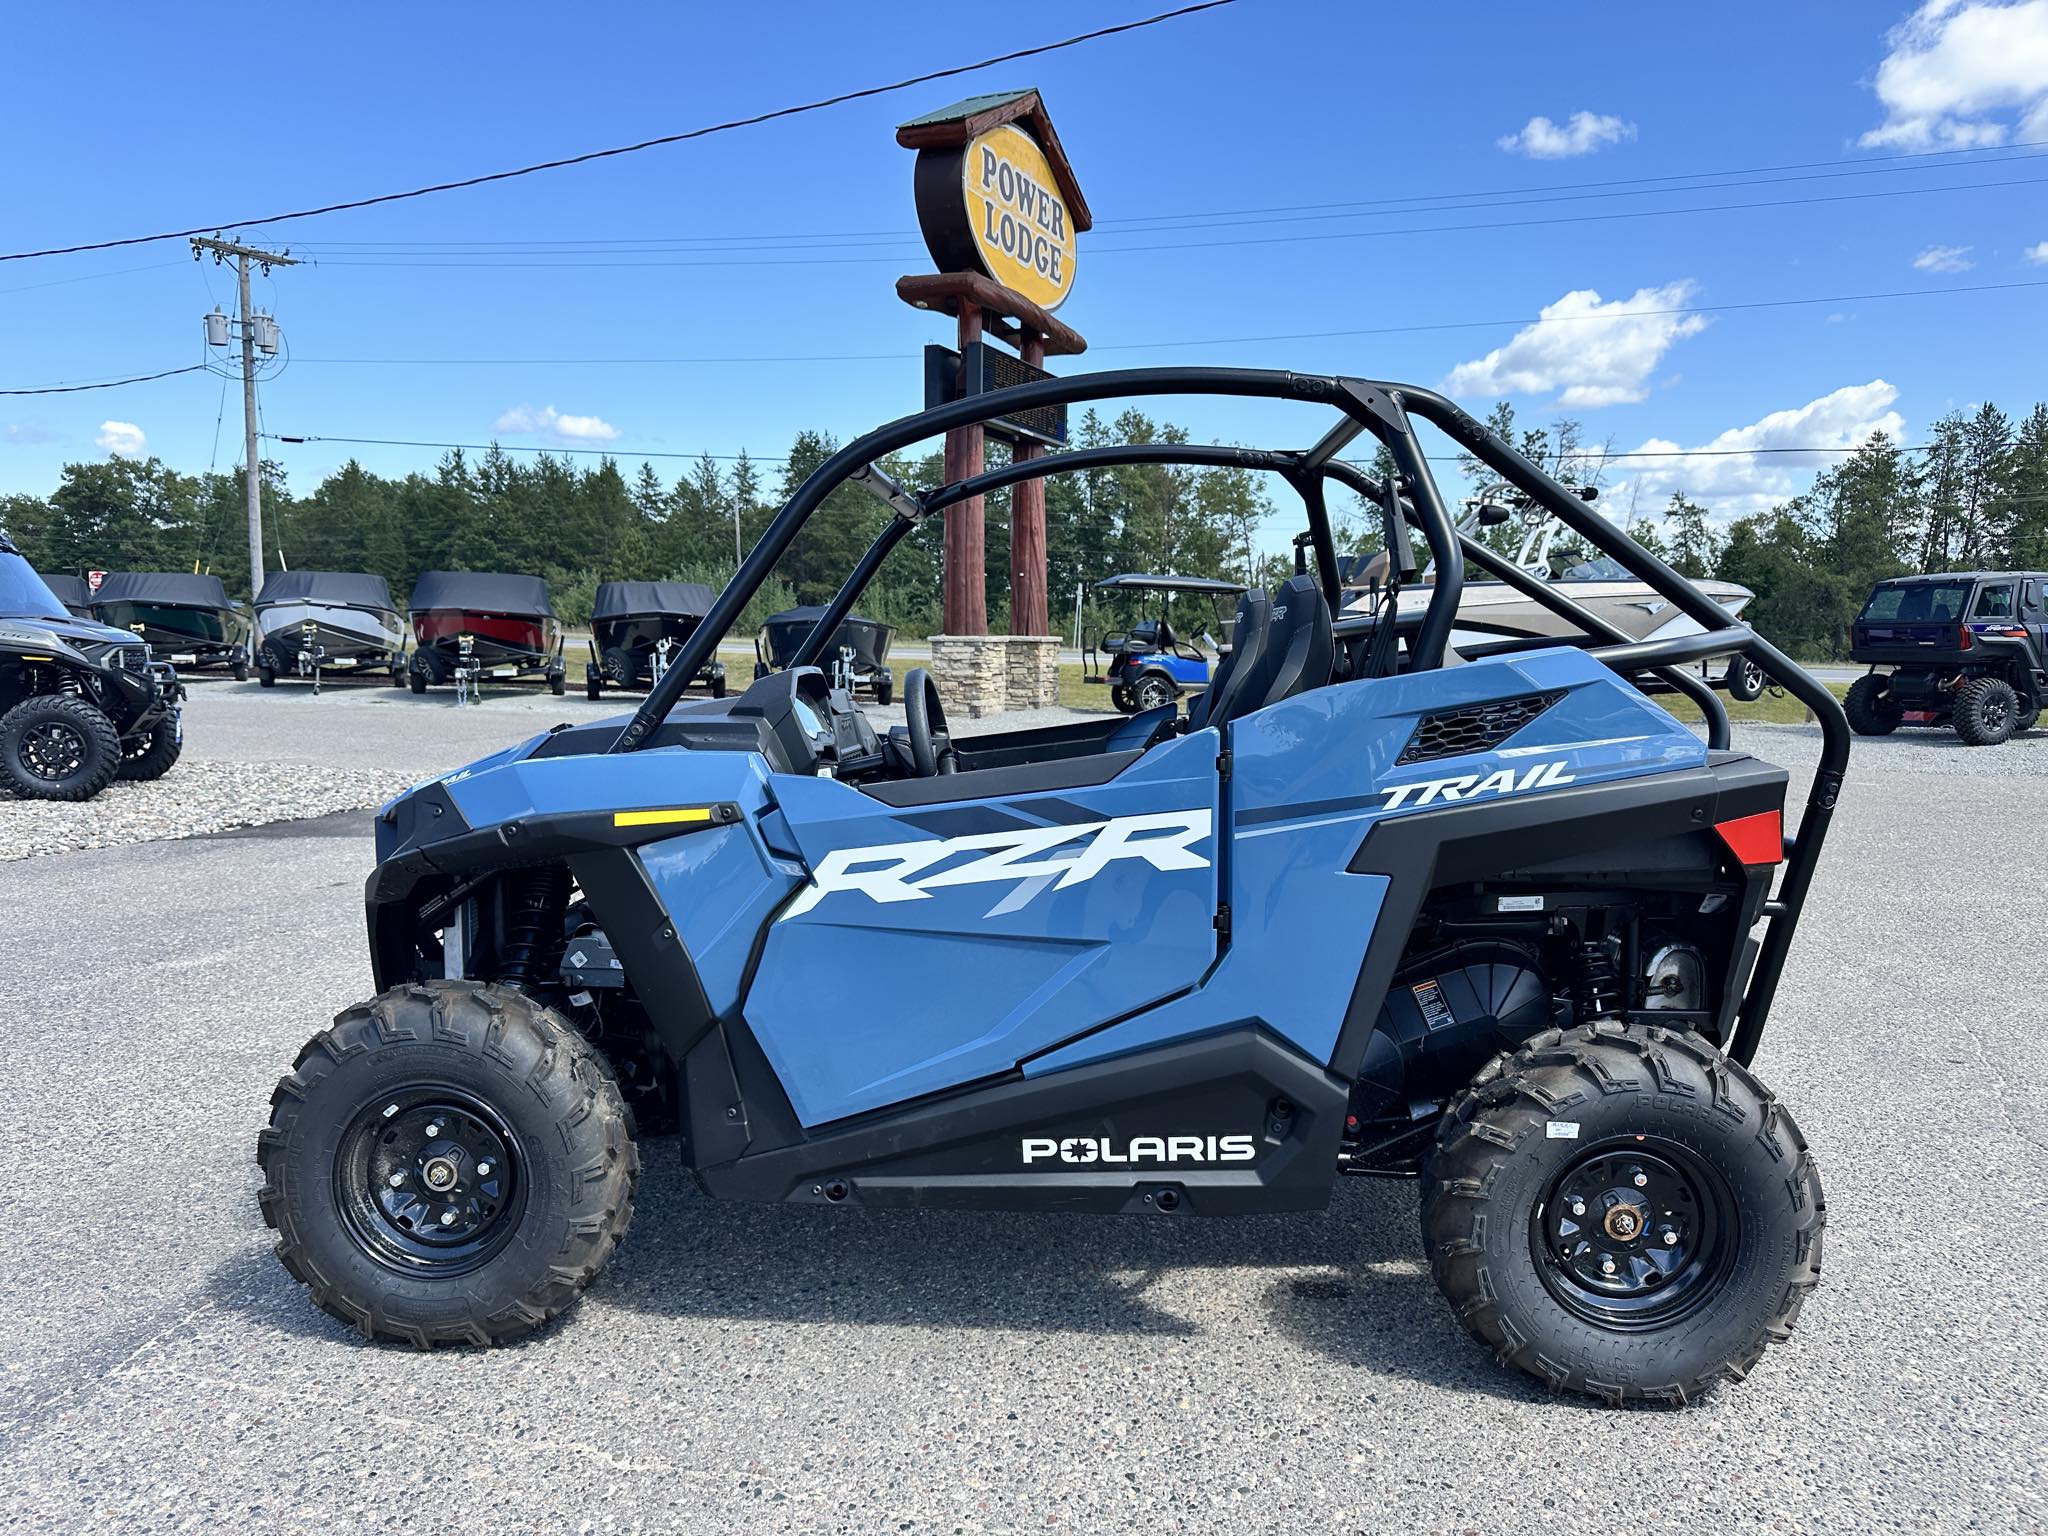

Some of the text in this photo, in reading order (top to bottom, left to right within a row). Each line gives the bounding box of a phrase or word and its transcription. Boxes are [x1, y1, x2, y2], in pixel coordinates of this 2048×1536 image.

[982, 146, 1065, 241] POWER
[985, 200, 1062, 284] LODGE
[1380, 760, 1576, 811] TRAIL
[779, 808, 1212, 922] RZR
[1022, 1135, 1256, 1164] POLARIS
